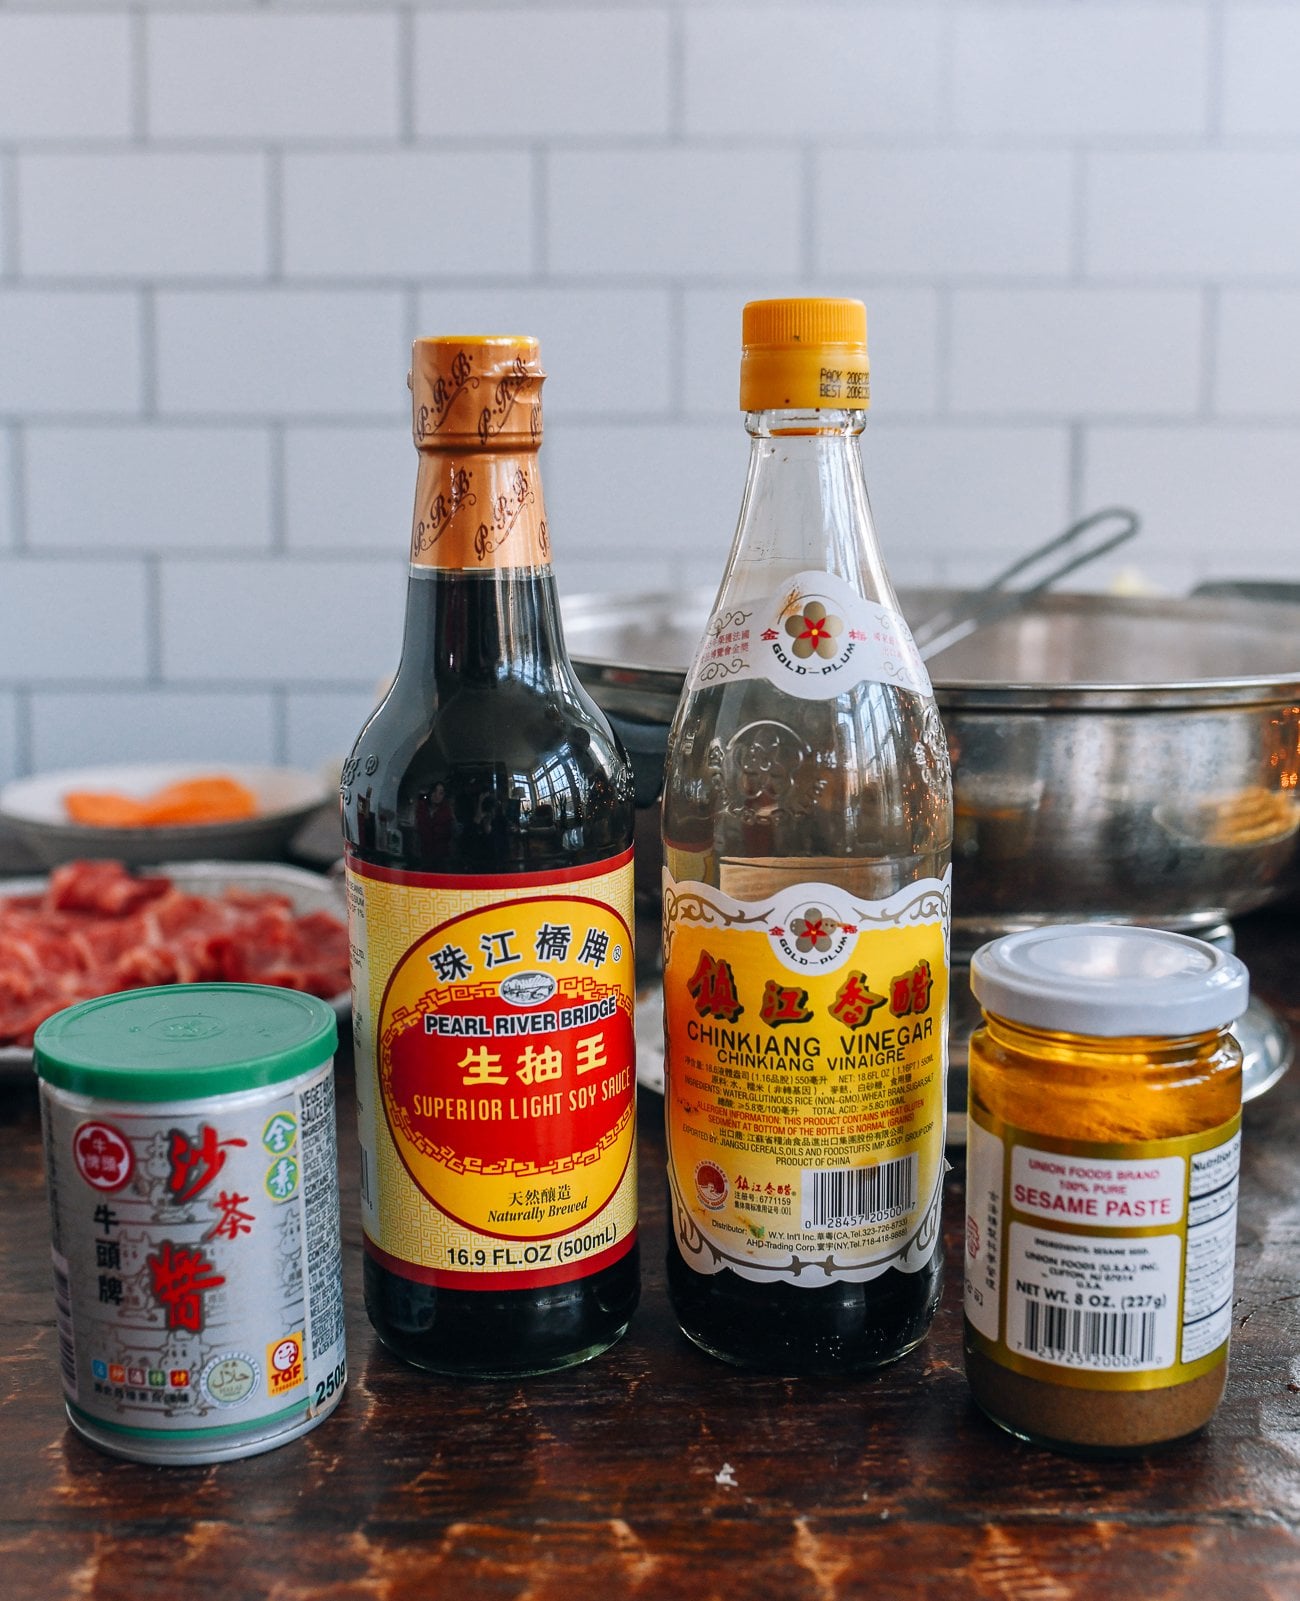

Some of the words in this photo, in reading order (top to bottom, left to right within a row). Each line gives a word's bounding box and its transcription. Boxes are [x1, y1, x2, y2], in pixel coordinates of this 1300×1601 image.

[760, 628, 779, 640] 金
[429, 923, 610, 983] 珠江橋牌
[425, 1014, 491, 1035] PEARL
[496, 1012, 556, 1036] RIVER
[560, 996, 616, 1029] BRIDGE
[688, 1020, 820, 1056] CHINKIANG
[840, 1018, 932, 1054] VINEGAR
[457, 1032, 607, 1086] 生抽王
[718, 1050, 814, 1072] CHINKIANG
[827, 1047, 905, 1070] VINAIGRE
[414, 1094, 502, 1120] SUPERIOR
[510, 1092, 562, 1120] LIGHT
[568, 1084, 597, 1112] SOY
[602, 1066, 630, 1102] SAUCE
[784, 1116, 801, 1125] THIS
[804, 1116, 840, 1125] PRODUCT
[842, 1112, 878, 1124] CONTAINS
[812, 1107, 836, 1116] TOTAL
[754, 1126, 786, 1134] BOTTOM
[800, 1128, 814, 1136] THE
[816, 1126, 844, 1136] BOTTLE
[847, 1125, 854, 1134] IS
[856, 1119, 885, 1133] NORMAL
[720, 1140, 749, 1150] JIANGSU
[806, 1148, 822, 1156] AND
[824, 1144, 870, 1156] FOODSTUFFS
[776, 1156, 812, 1166] PRODUCT
[815, 1158, 824, 1166] OF
[827, 1156, 850, 1166] CHINA
[1028, 1158, 1066, 1176] UNION
[1068, 1166, 1112, 1180] FOODS
[1117, 1170, 1160, 1181] BRAND
[1014, 1184, 1098, 1216] SESAME
[1106, 1198, 1170, 1216] PASTE
[1094, 1184, 1127, 1194] PURE
[488, 1200, 546, 1223] Naturally
[548, 1196, 588, 1218] Brewed
[805, 1220, 812, 1228] 0
[828, 1215, 864, 1228] 28457
[870, 1206, 902, 1223] 20500
[448, 1248, 486, 1266] 16.9
[493, 1244, 552, 1266] FL.OZ
[558, 1222, 618, 1262] (500mL)
[746, 1238, 794, 1252] AHD-Trading
[796, 1244, 816, 1252] Corp.
[768, 1232, 784, 1240] W.Y.
[94, 1204, 124, 1306] 牛頭牌
[1025, 1252, 1058, 1265] UNION
[1060, 1259, 1096, 1270] FOODS
[1016, 1280, 1040, 1296] NET
[1044, 1287, 1068, 1303] WT.
[1075, 1290, 1083, 1306] 8
[1088, 1294, 1114, 1309] OZ.
[1121, 1293, 1166, 1311] (227g)
[316, 1358, 345, 1407] 250g
